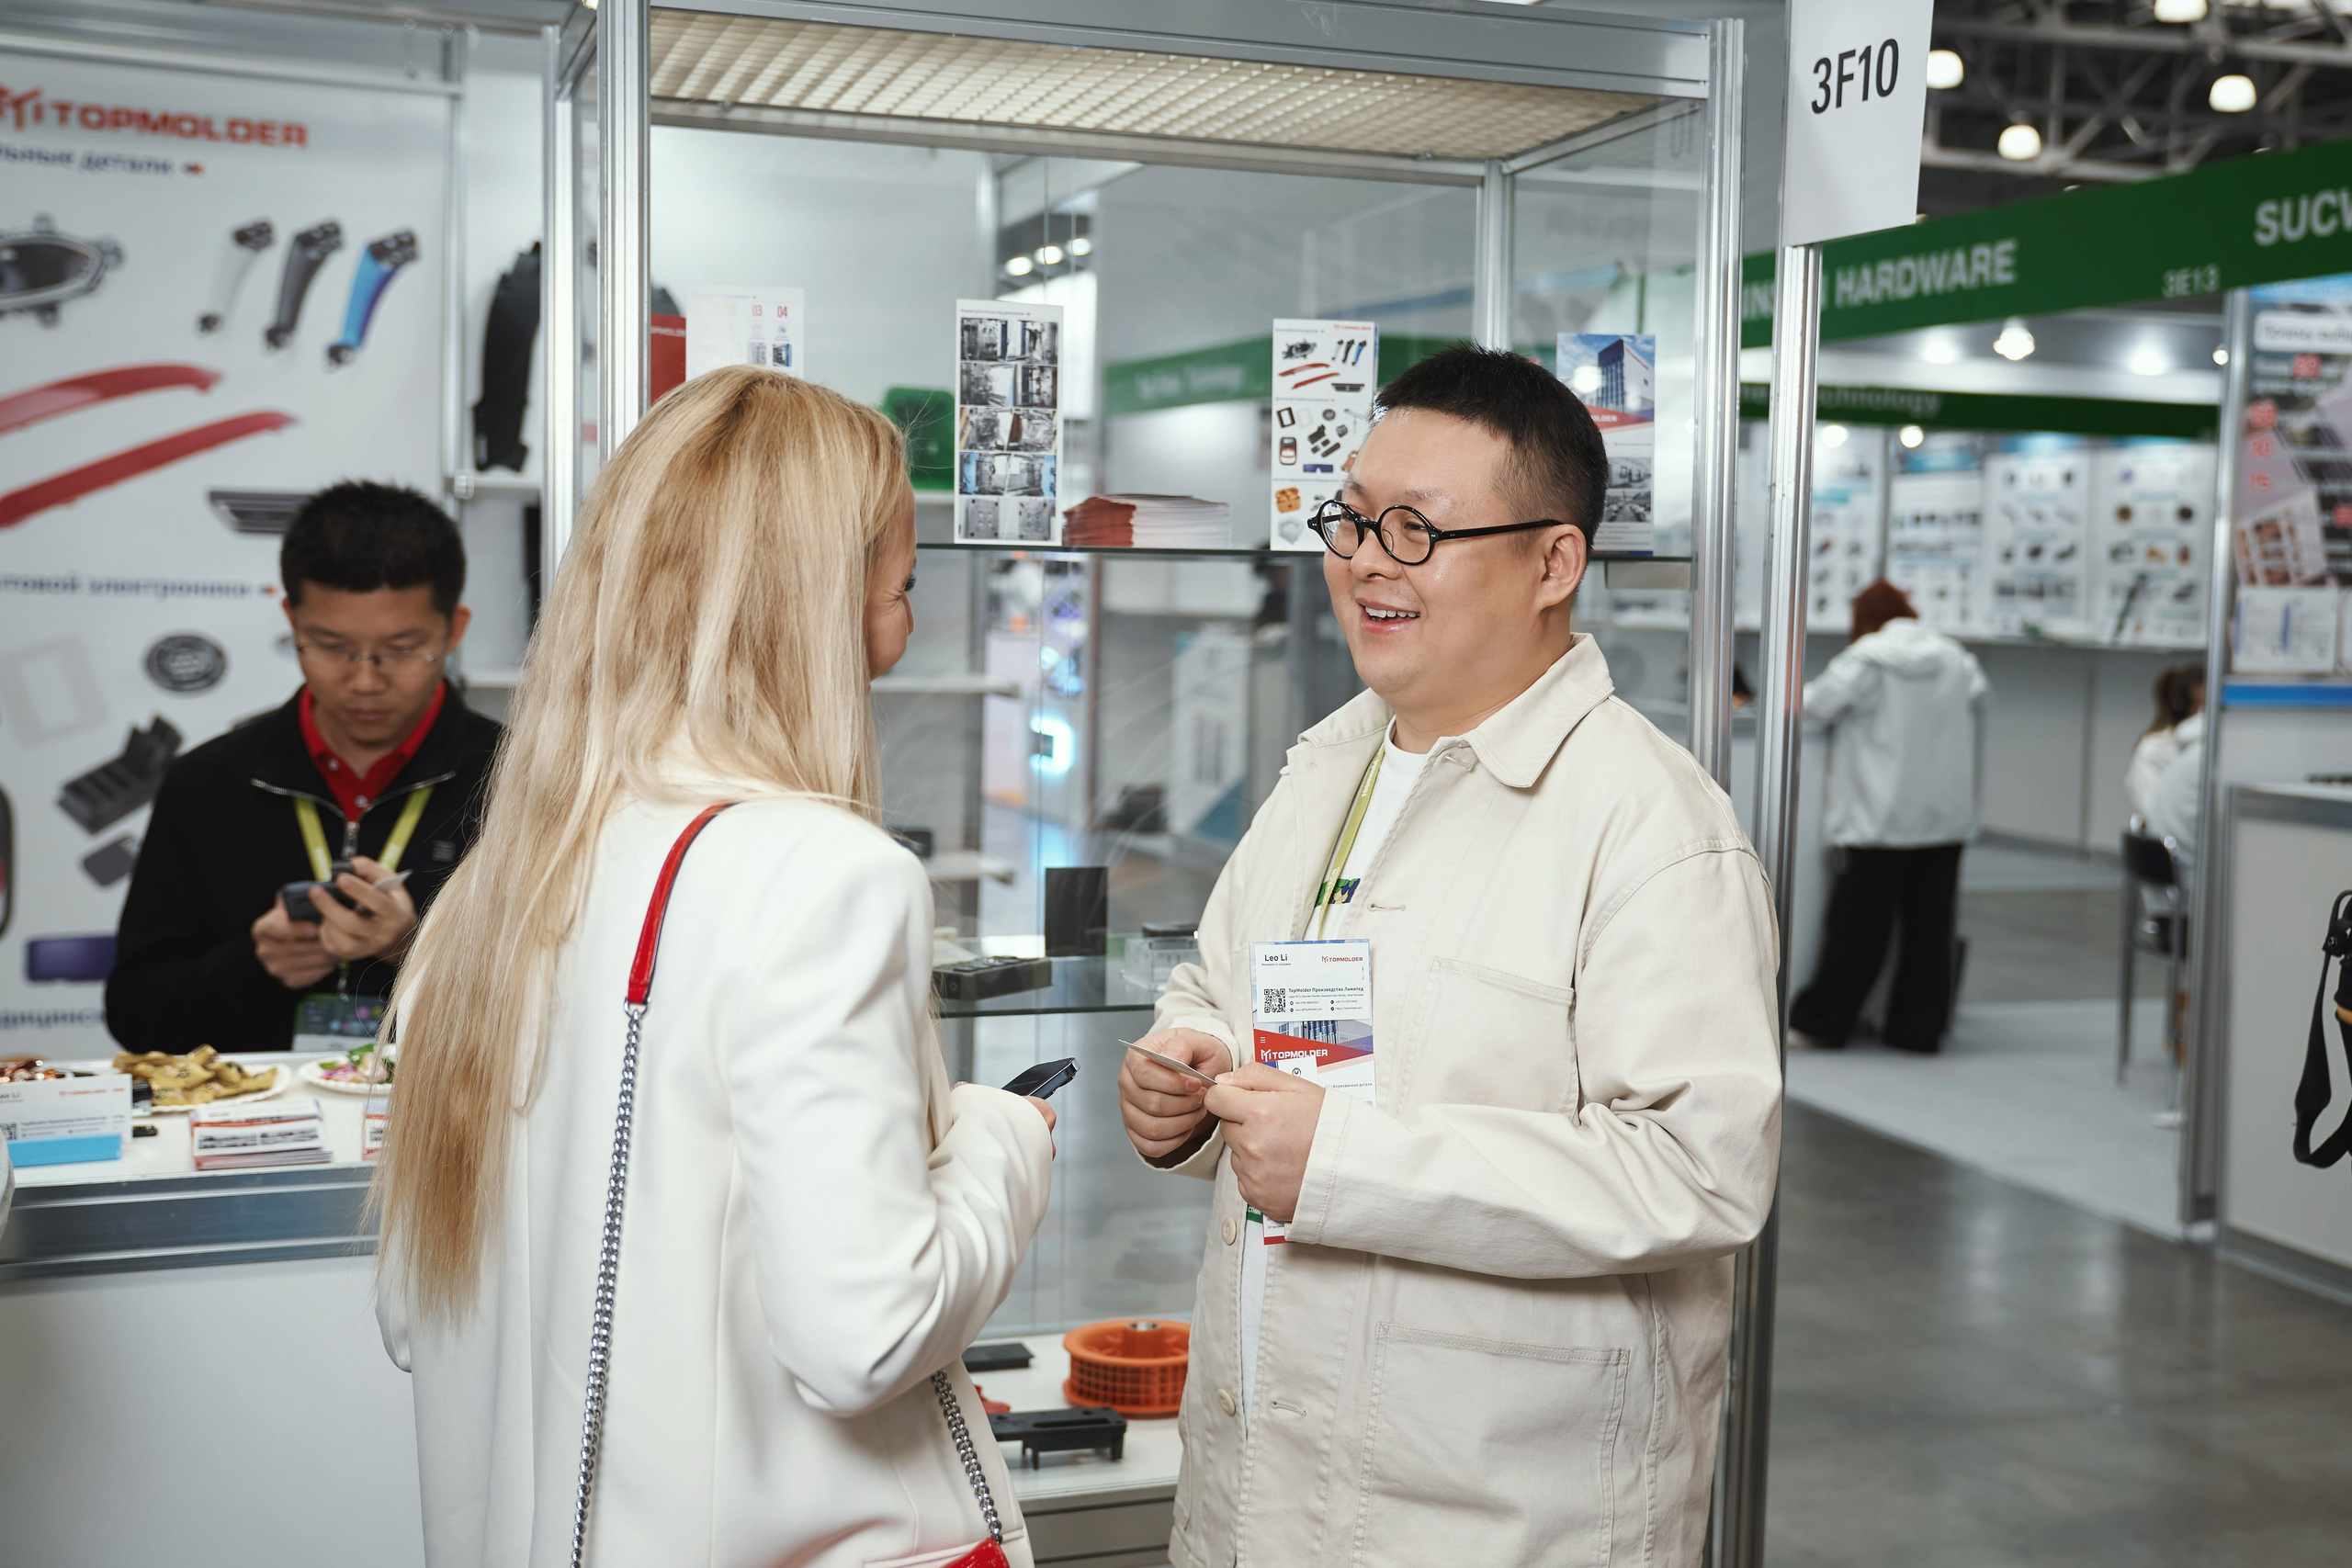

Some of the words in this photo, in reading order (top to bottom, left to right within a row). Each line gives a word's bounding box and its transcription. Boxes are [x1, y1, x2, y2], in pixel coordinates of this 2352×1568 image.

[1811, 38, 1899, 115] 3F10
[51, 98, 309, 149] TOPMOLDER
[1834, 237, 2018, 309] HARDWARE
[2162, 263, 2221, 299] 3E13
[752, 304, 763, 317] 03
[776, 305, 788, 319] 04
[1264, 953, 1279, 962] Leo
[1280, 953, 1288, 962] Li
[1272, 1048, 1329, 1059] TOPMOLDER
